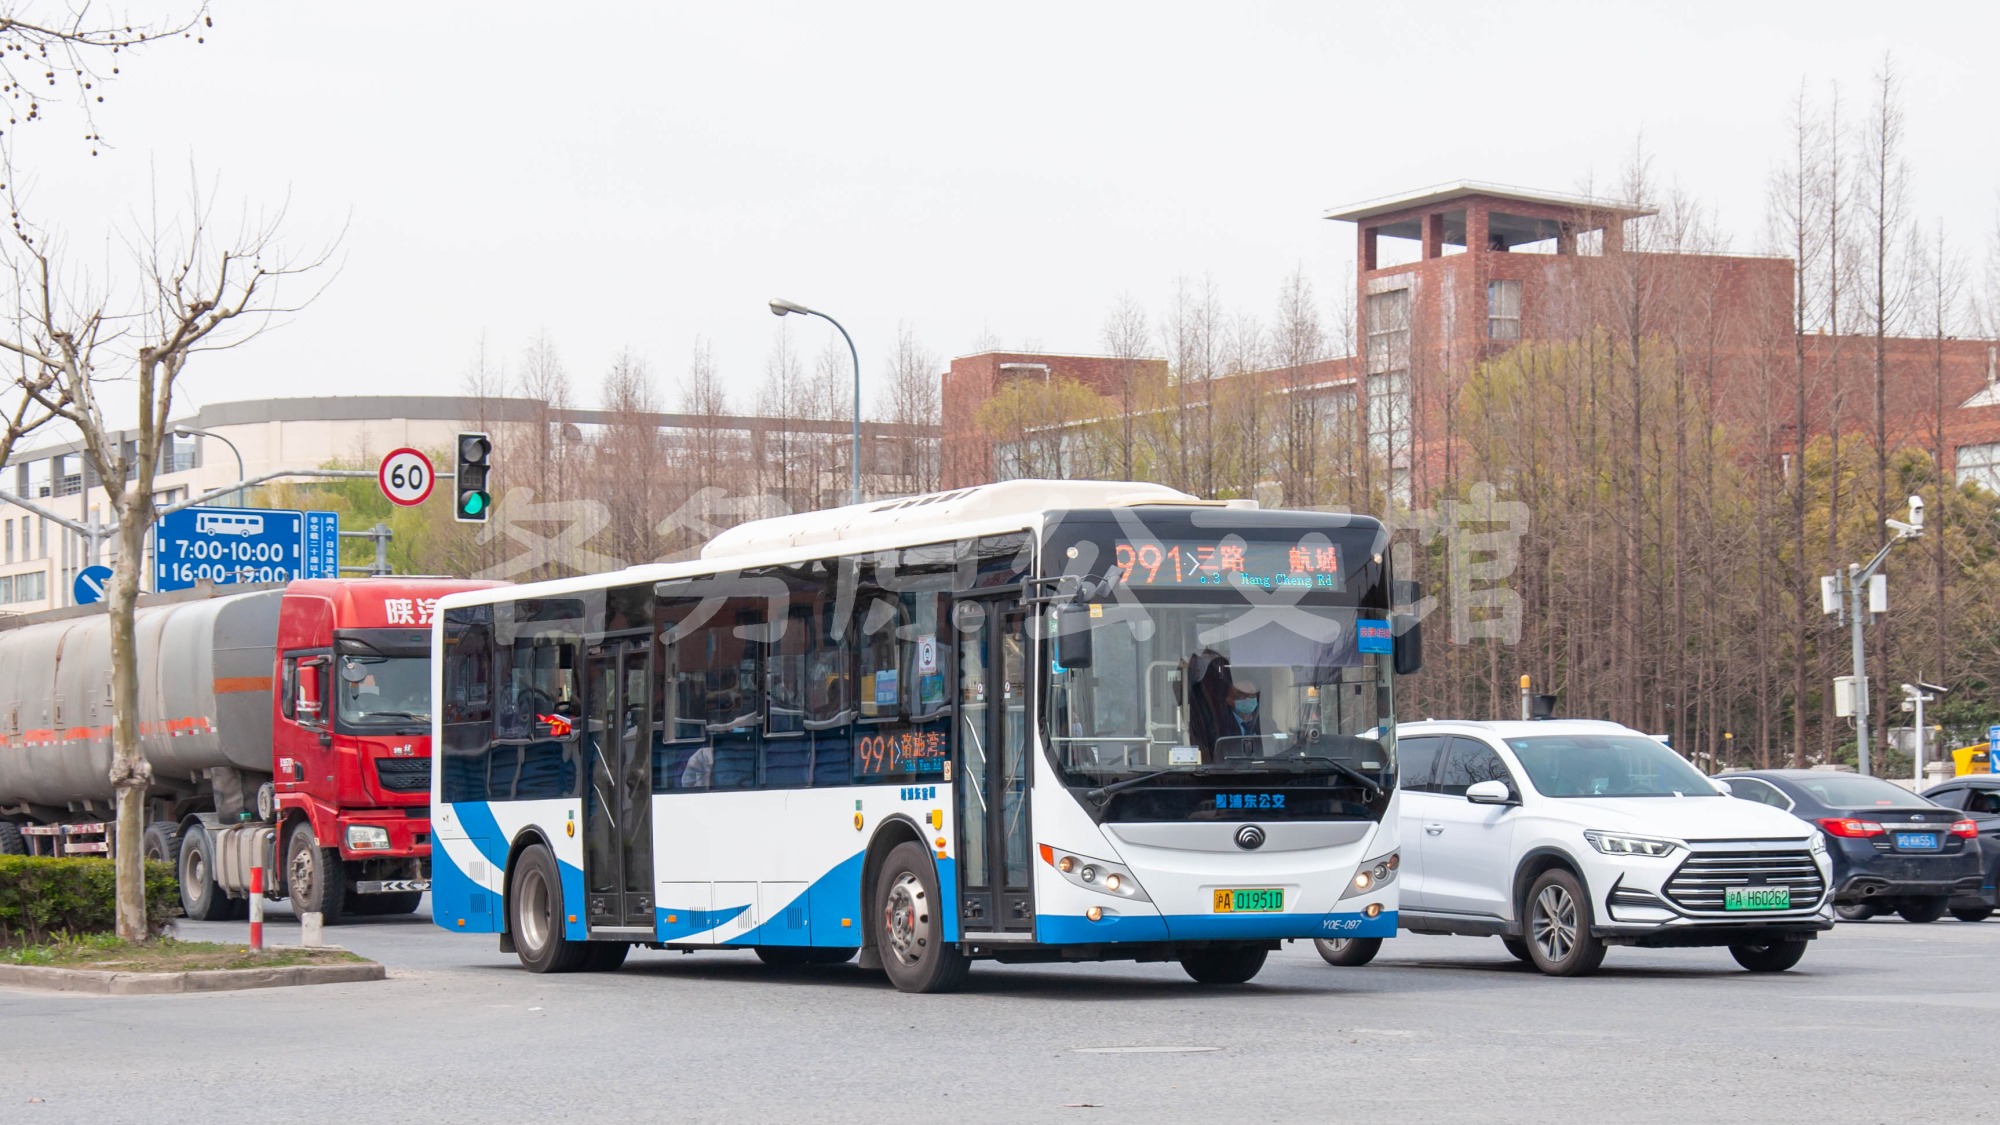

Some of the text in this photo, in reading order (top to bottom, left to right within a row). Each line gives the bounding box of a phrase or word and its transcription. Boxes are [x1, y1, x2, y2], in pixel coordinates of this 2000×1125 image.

[391, 463, 423, 490] 60
[175, 539, 284, 562] 7:00-10:00
[1115, 543, 1182, 584] 991
[1197, 544, 1338, 573] 三路 航城
[1275, 573, 1312, 588] Cheng
[1316, 574, 1333, 586] Rd
[860, 735, 895, 774] 991
[1229, 793, 1286, 808] 浦东公交
